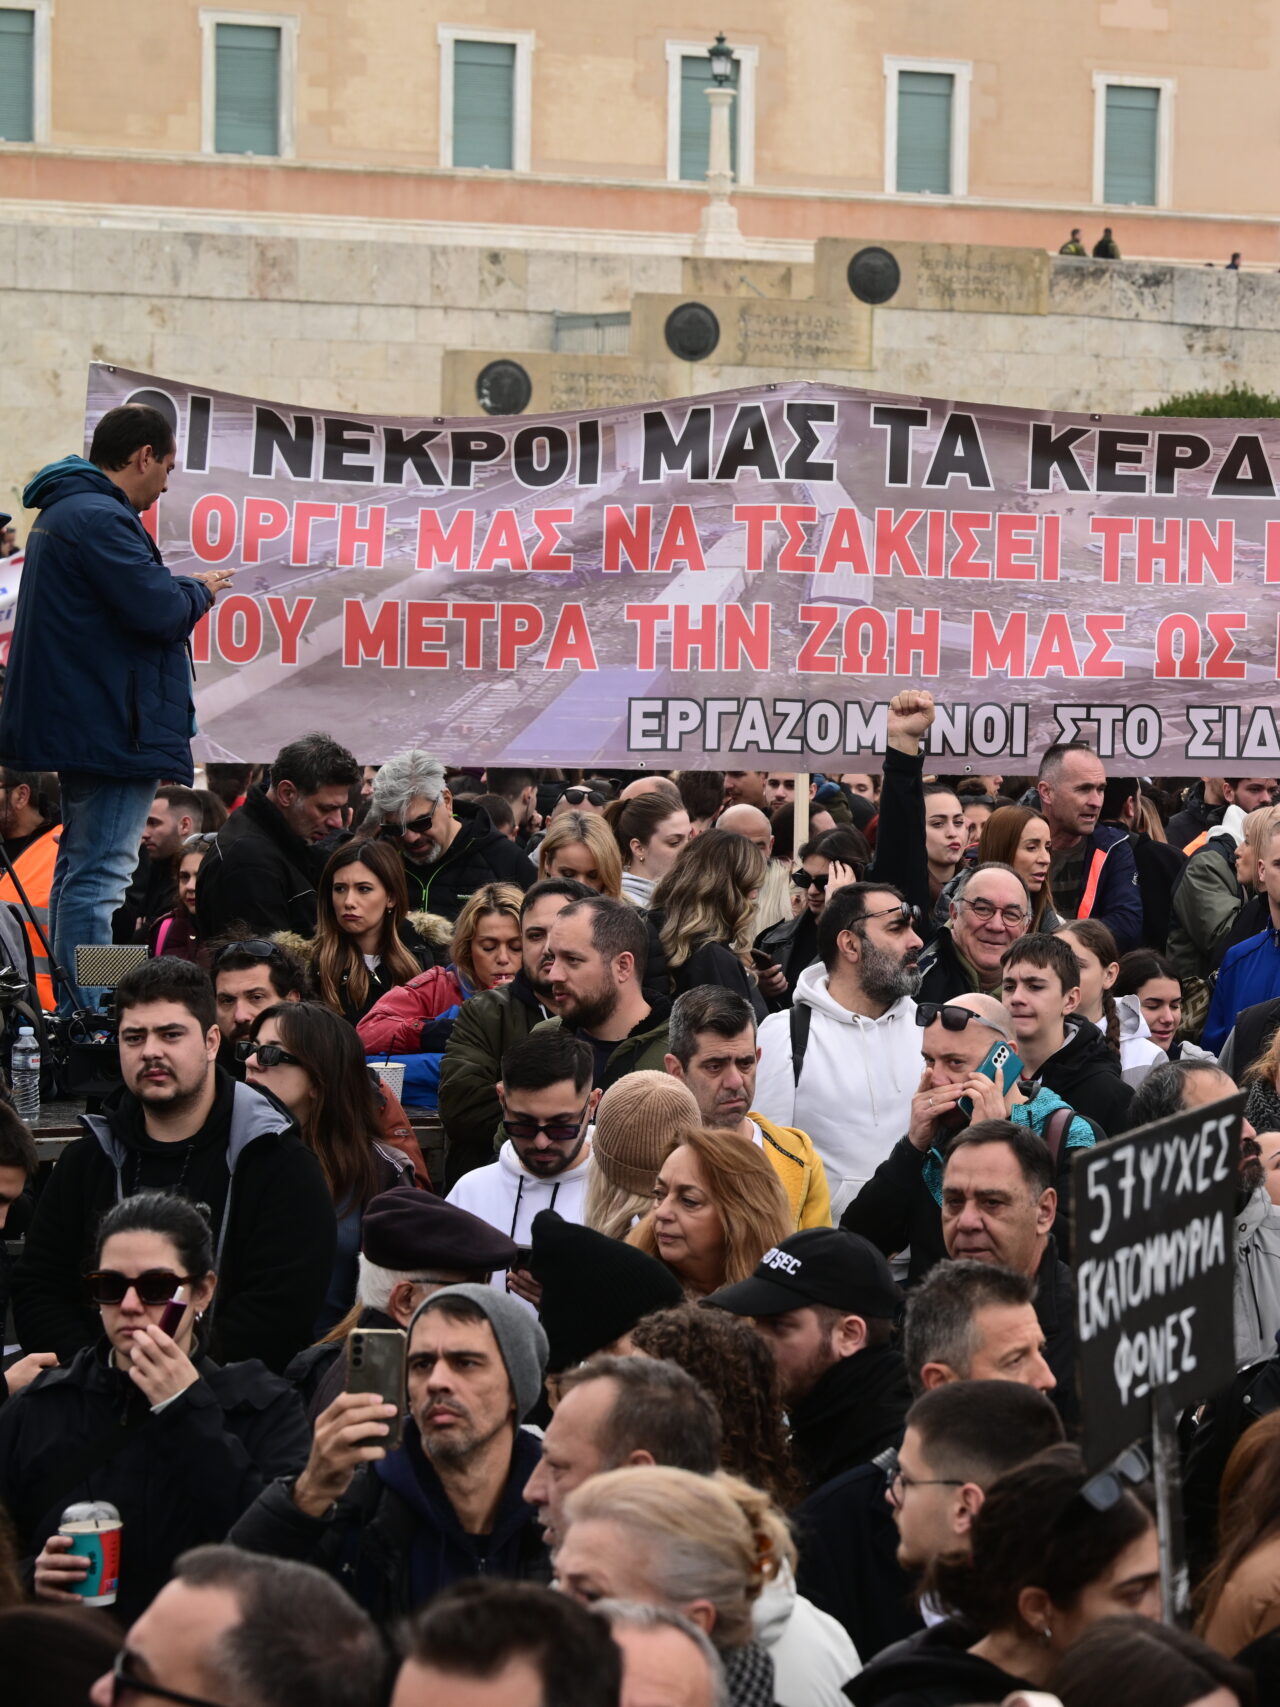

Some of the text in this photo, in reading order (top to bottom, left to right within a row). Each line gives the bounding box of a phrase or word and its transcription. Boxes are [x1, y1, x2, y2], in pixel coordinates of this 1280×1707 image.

[250, 405, 602, 490] ΝΕΚΡΟΙ
[640, 402, 837, 484] ΜΑΣ
[871, 402, 994, 491] ΤΑ
[190, 493, 387, 569] ΟΡΓΗ
[415, 507, 574, 573] ΜΑΣ
[603, 504, 707, 574] ΝΑ
[734, 504, 1061, 583] ΤΣΑΚΙΣΕΙ
[1091, 516, 1236, 586] ΤΗΝ
[343, 600, 598, 671] ΜΕΤΡΑ
[625, 603, 773, 672] ΤΗΝ
[797, 604, 941, 677] ΖΩΗ
[970, 610, 1125, 678] ΜΑΣ
[1153, 612, 1249, 680] ΩΣ
[628, 697, 1029, 758] ΕΡΓΑΖΟΜΝΟΙ
[1053, 702, 1163, 759] ΣΤΟ
[1077, 1210, 1225, 1342] ΕΚΑΤΟΜΜΥΡΙΑ
